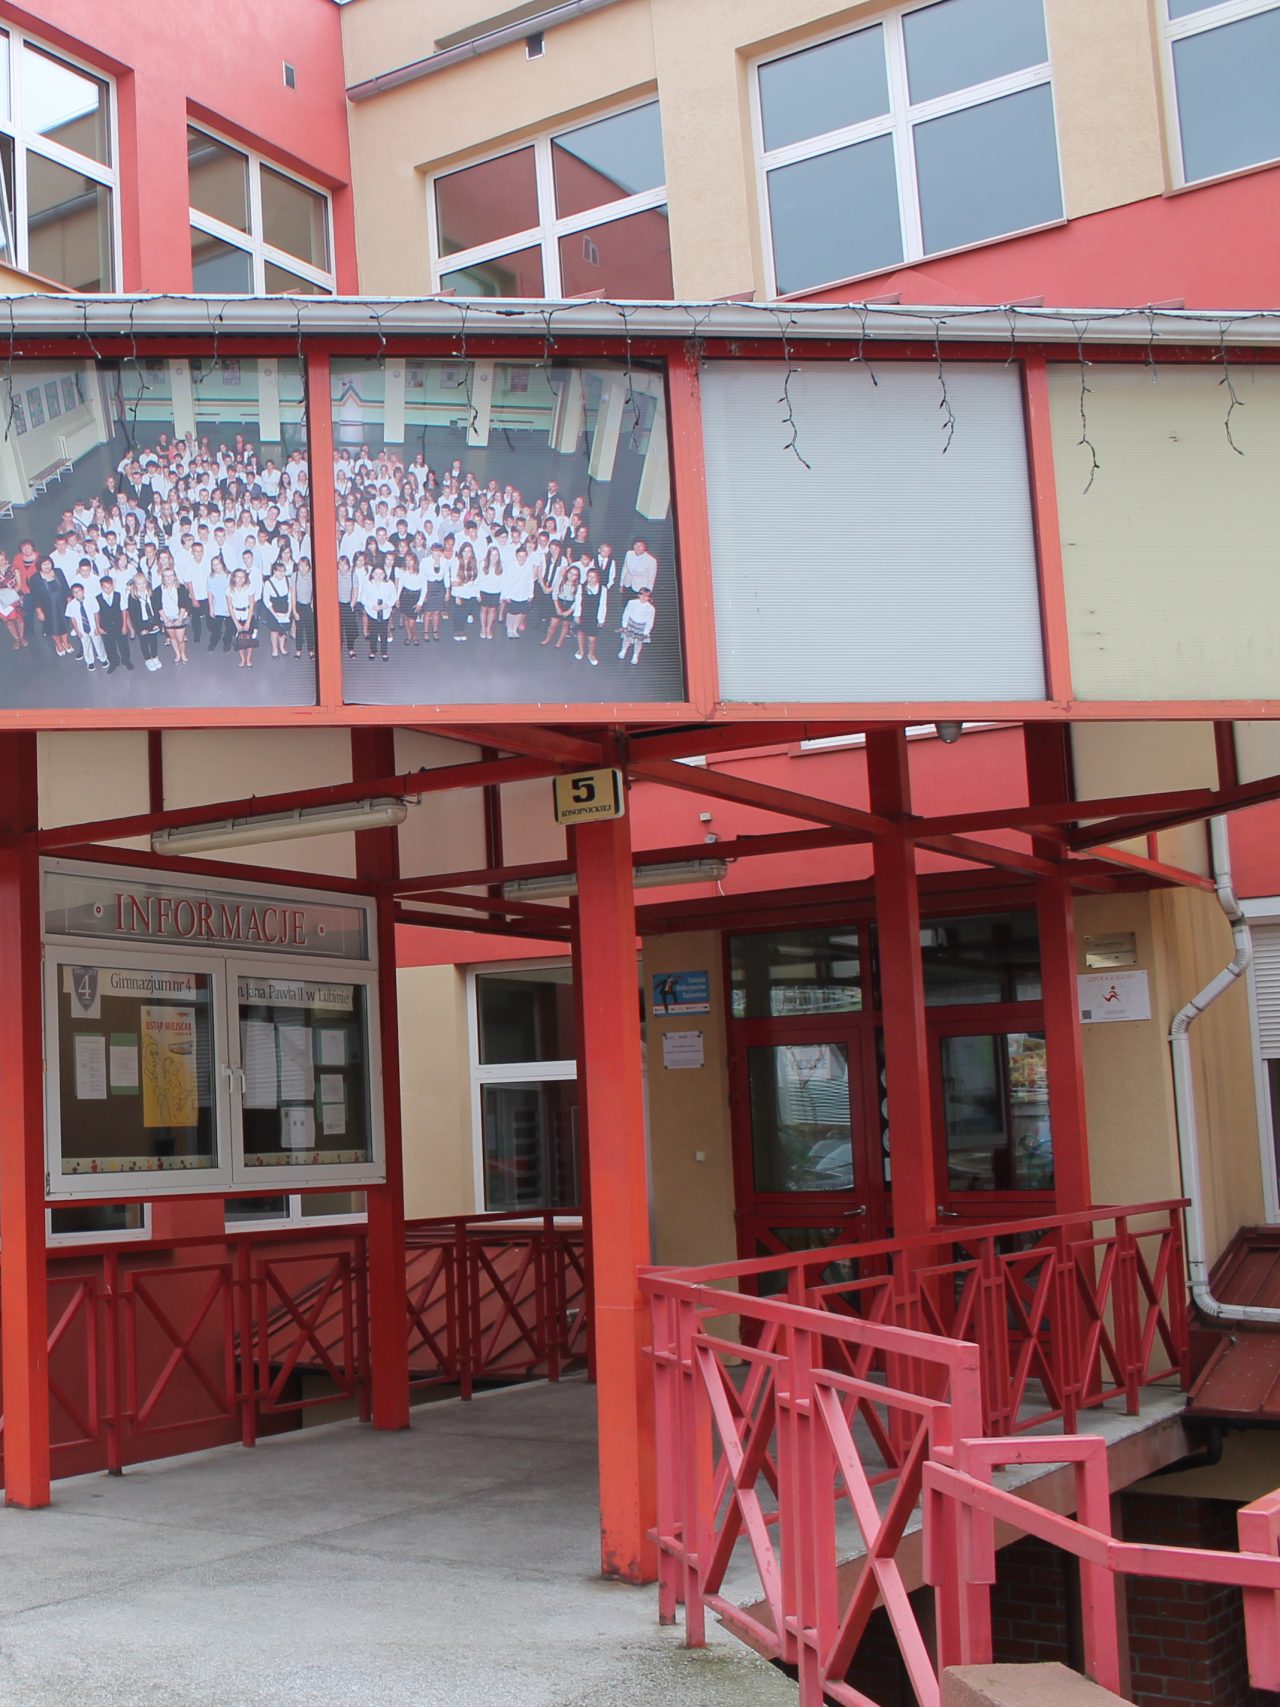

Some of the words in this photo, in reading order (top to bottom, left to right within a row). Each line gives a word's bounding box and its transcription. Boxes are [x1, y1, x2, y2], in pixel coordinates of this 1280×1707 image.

[572, 776, 595, 803] 5
[561, 804, 611, 817] KONOPNICKIEJ
[114, 893, 308, 945] INFORMACJE
[78, 974, 92, 1000] 4
[110, 972, 172, 994] Gimnazjum
[172, 981, 184, 992] nr
[185, 978, 191, 993] 4
[245, 983, 266, 1000] Jana
[306, 991, 316, 1002] w
[318, 988, 350, 1004] Lubinie
